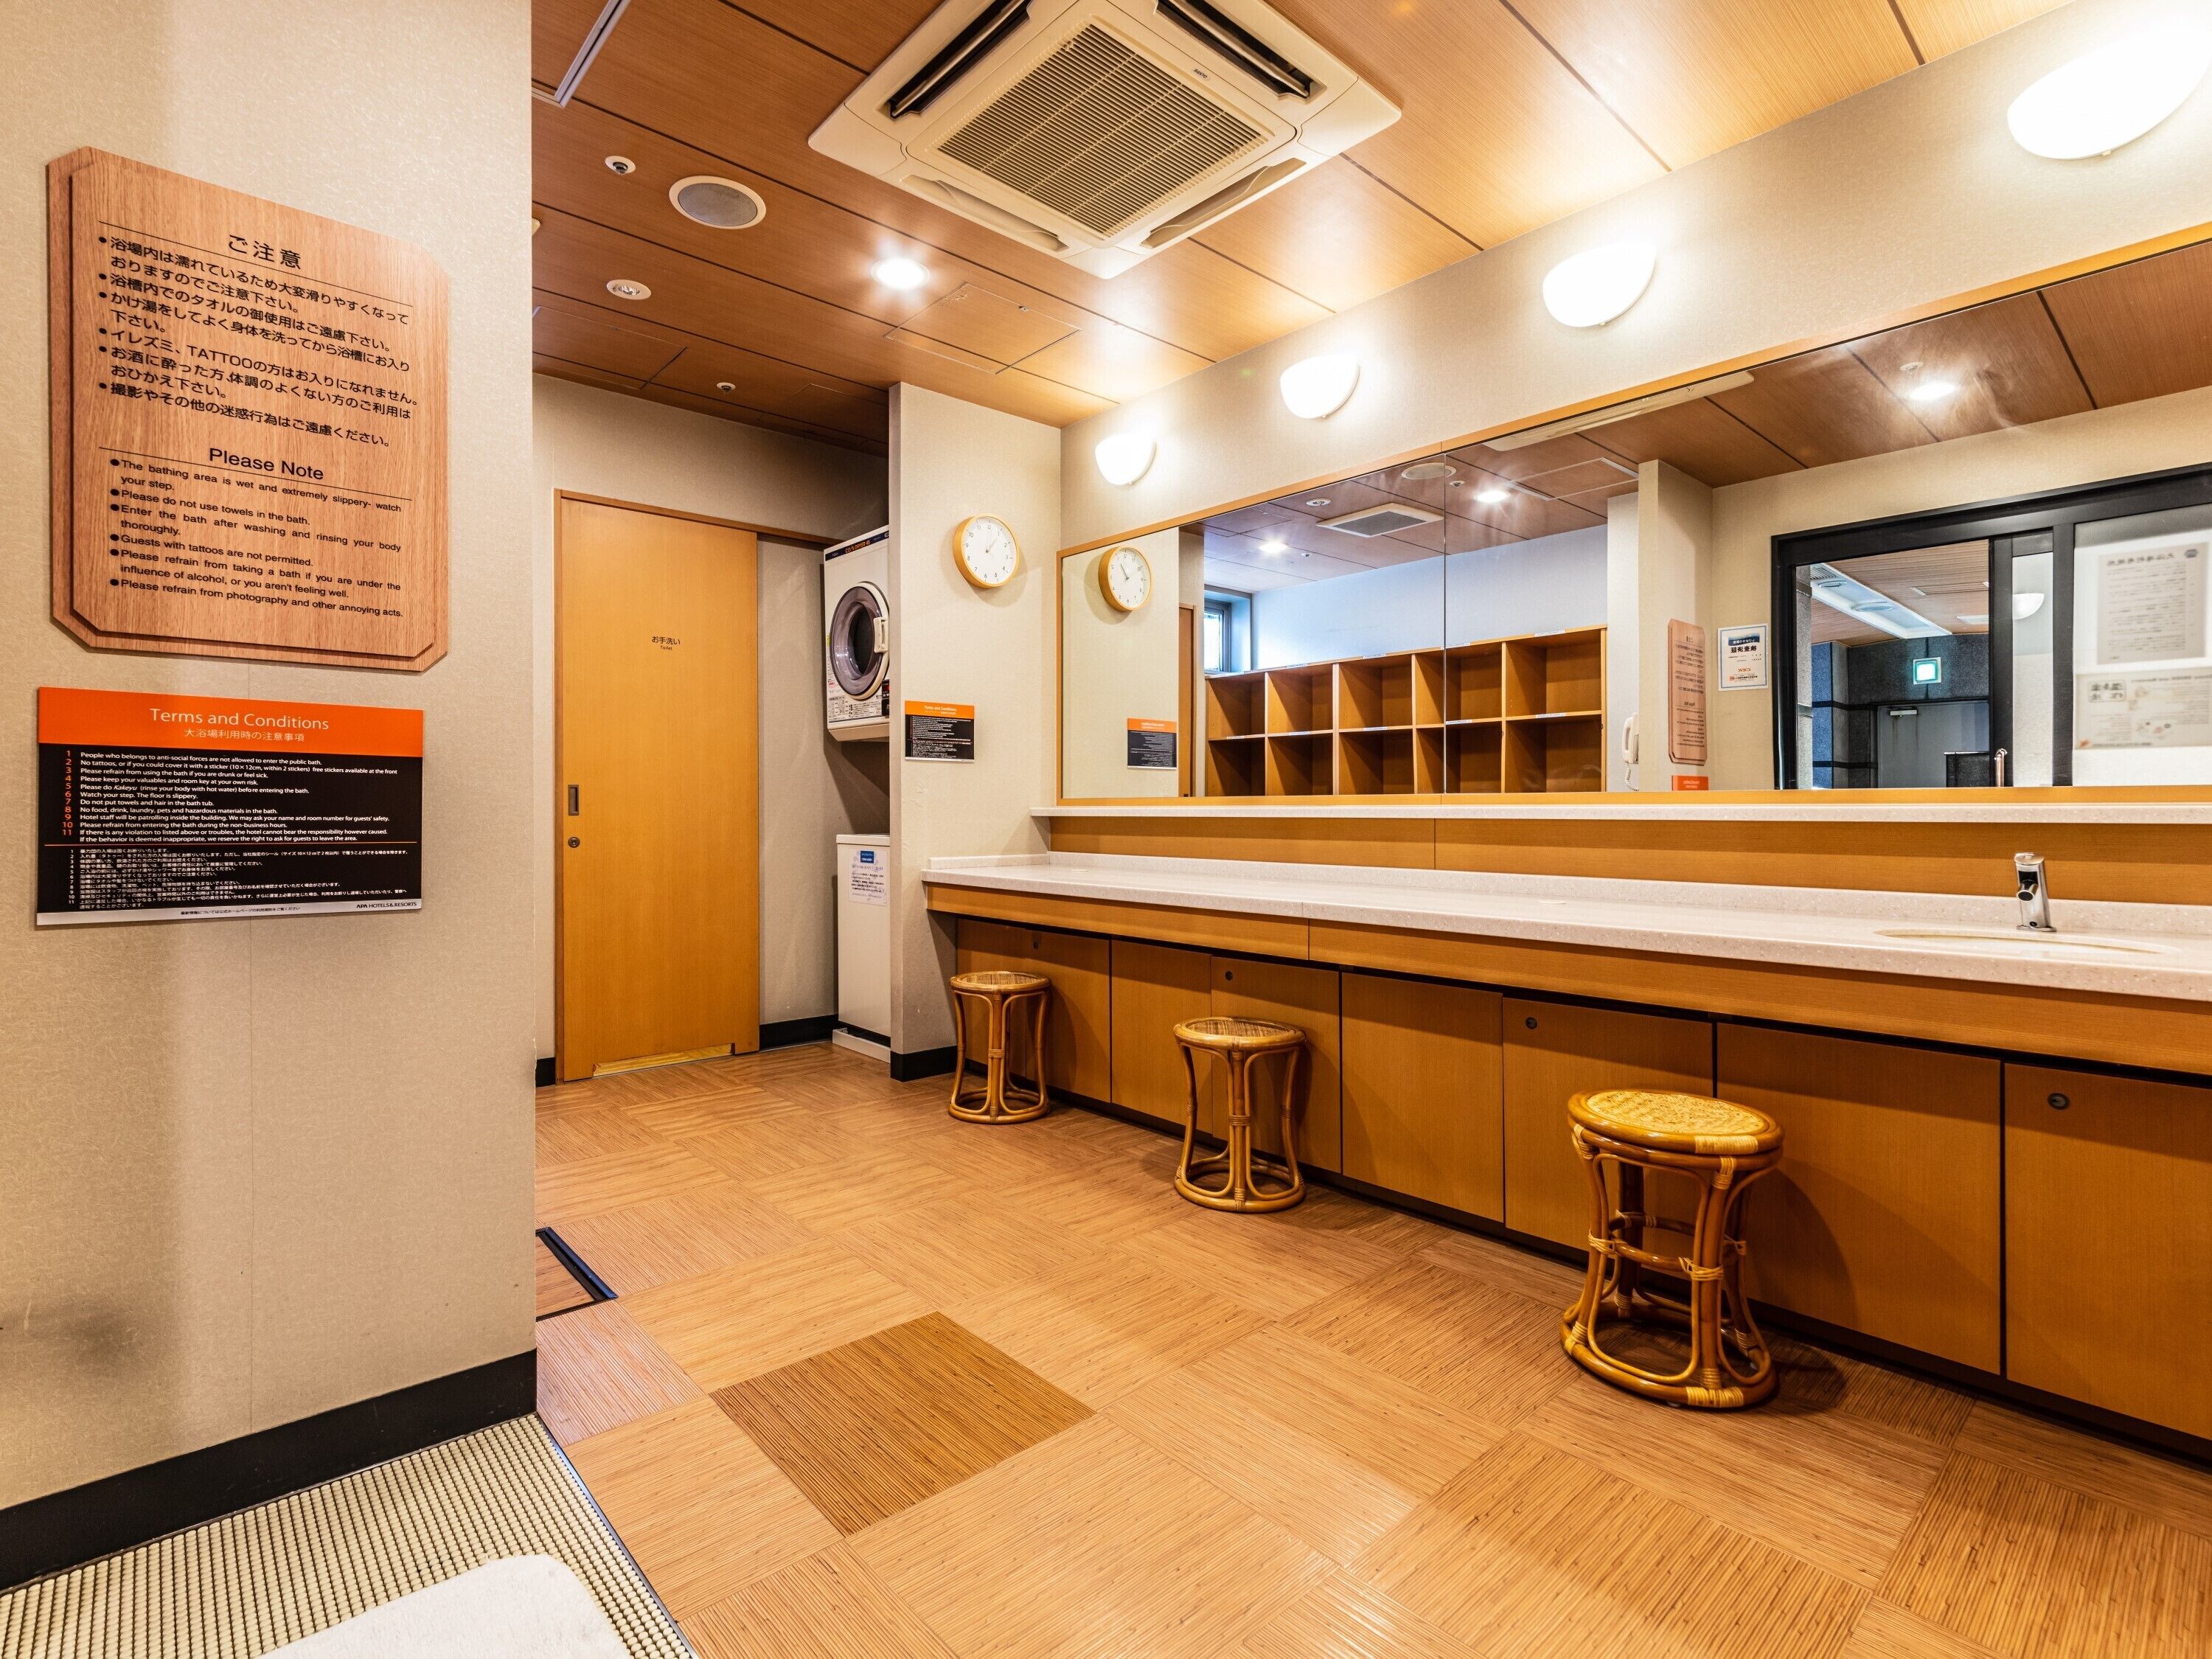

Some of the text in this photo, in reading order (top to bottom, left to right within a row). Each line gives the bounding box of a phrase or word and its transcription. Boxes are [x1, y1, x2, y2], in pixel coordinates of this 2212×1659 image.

[228, 234, 302, 271] ご注意
[209, 447, 324, 481] Please Note
[120, 476, 175, 491] your step.
[121, 459, 401, 512] The bathing area is wet and extremely slippery- watch
[121, 489, 310, 525] Please do not use towels in the bath.
[120, 520, 181, 536] thoroughly.
[121, 504, 401, 553] Enter the bath after washing and rinsing your body
[120, 534, 313, 566] Guests with tattoos are not permitted.
[120, 549, 159, 562] Please
[164, 556, 198, 566] refrain
[204, 560, 228, 570] from
[232, 563, 263, 576] taking
[279, 568, 301, 579] bath
[315, 574, 333, 582] you
[357, 580, 383, 588] under
[386, 582, 401, 591] the
[120, 564, 170, 577] influence
[173, 571, 184, 579] of
[187, 572, 227, 585] alcohol,
[243, 580, 262, 588] you
[265, 582, 292, 591] aren't
[294, 584, 326, 597] feeling
[328, 590, 349, 598] well.
[121, 579, 159, 591] Please
[162, 585, 196, 595] refrain
[199, 588, 223, 597] from
[226, 591, 288, 606] photography
[312, 601, 337, 610] other
[338, 605, 380, 616] annoying
[382, 609, 403, 617] acts.
[652, 636, 681, 645] お手洗い
[150, 707, 330, 730] Terms and Conditions
[184, 728, 305, 742] 大浴場利用時の注意事項
[121, 753, 147, 761] belongs
